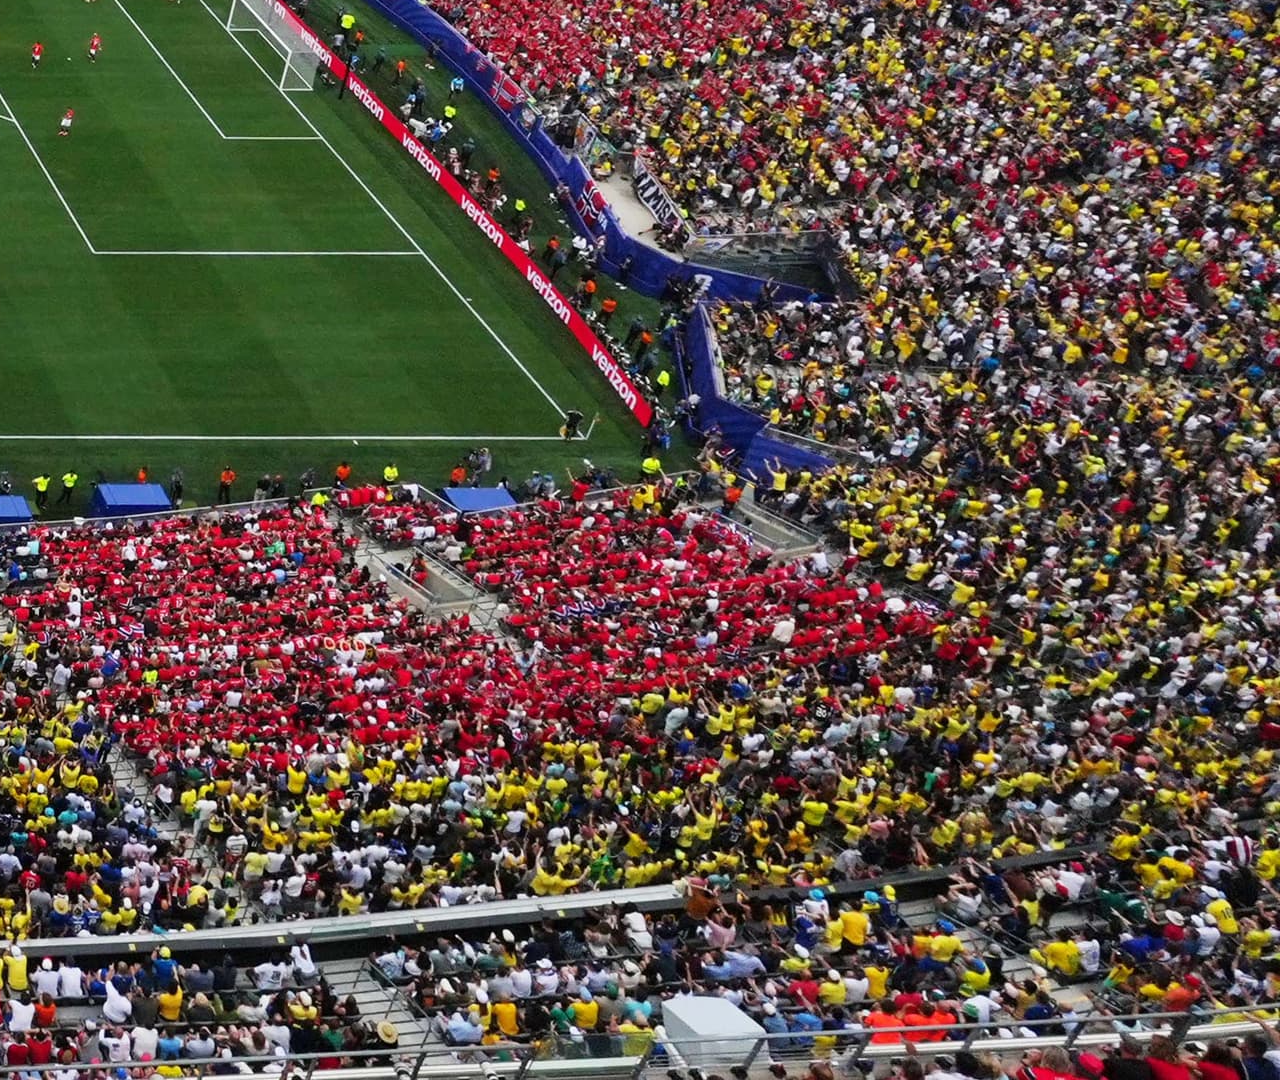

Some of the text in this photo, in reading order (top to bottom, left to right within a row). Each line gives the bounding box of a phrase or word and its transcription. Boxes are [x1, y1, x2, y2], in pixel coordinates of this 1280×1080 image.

[299, 27, 333, 68] verizon
[348, 76, 385, 120] verizon
[402, 132, 442, 181] verizon
[460, 193, 505, 248] verizon
[526, 263, 572, 326] verizon
[591, 343, 638, 411] verizon
